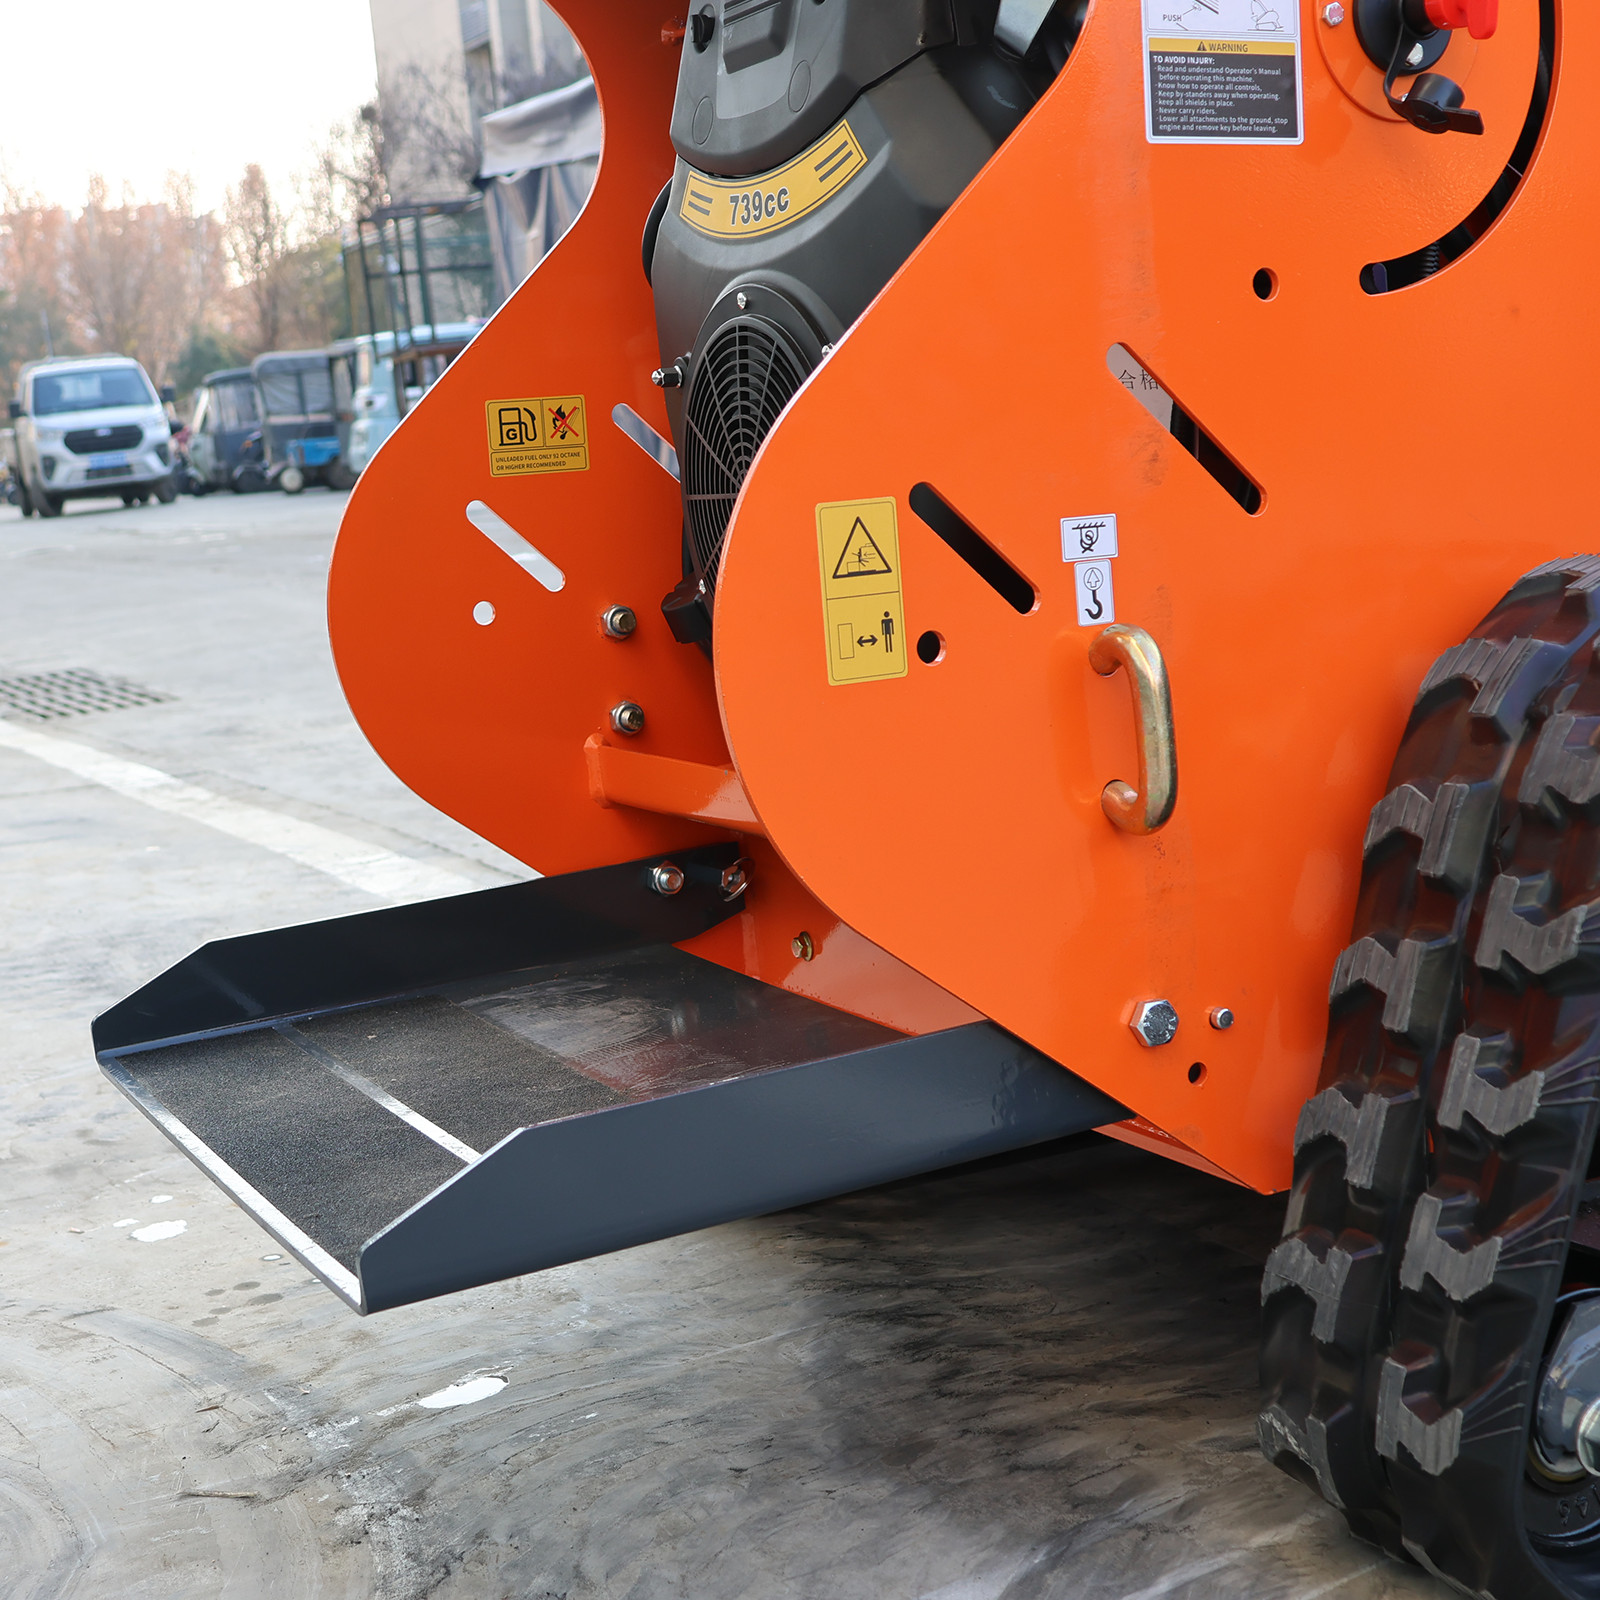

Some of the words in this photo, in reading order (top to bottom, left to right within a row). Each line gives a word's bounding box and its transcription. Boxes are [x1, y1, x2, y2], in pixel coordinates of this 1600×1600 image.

[1162, 14, 1182, 22] PUSH
[1209, 43, 1248, 52] WARNING
[1187, 56, 1215, 64] INJURY:
[1225, 67, 1257, 75] Operator's
[1181, 74, 1212, 82] operating
[1158, 90, 1174, 98] Keep
[1249, 93, 1280, 101] operating.
[1158, 98, 1174, 106] keep
[1249, 117, 1273, 126] ground,
[1160, 124, 1180, 132] engine
[1220, 124, 1231, 132] key
[1254, 125, 1278, 133] leaving.
[729, 186, 790, 226] 739cc
[506, 428, 518, 440] G
